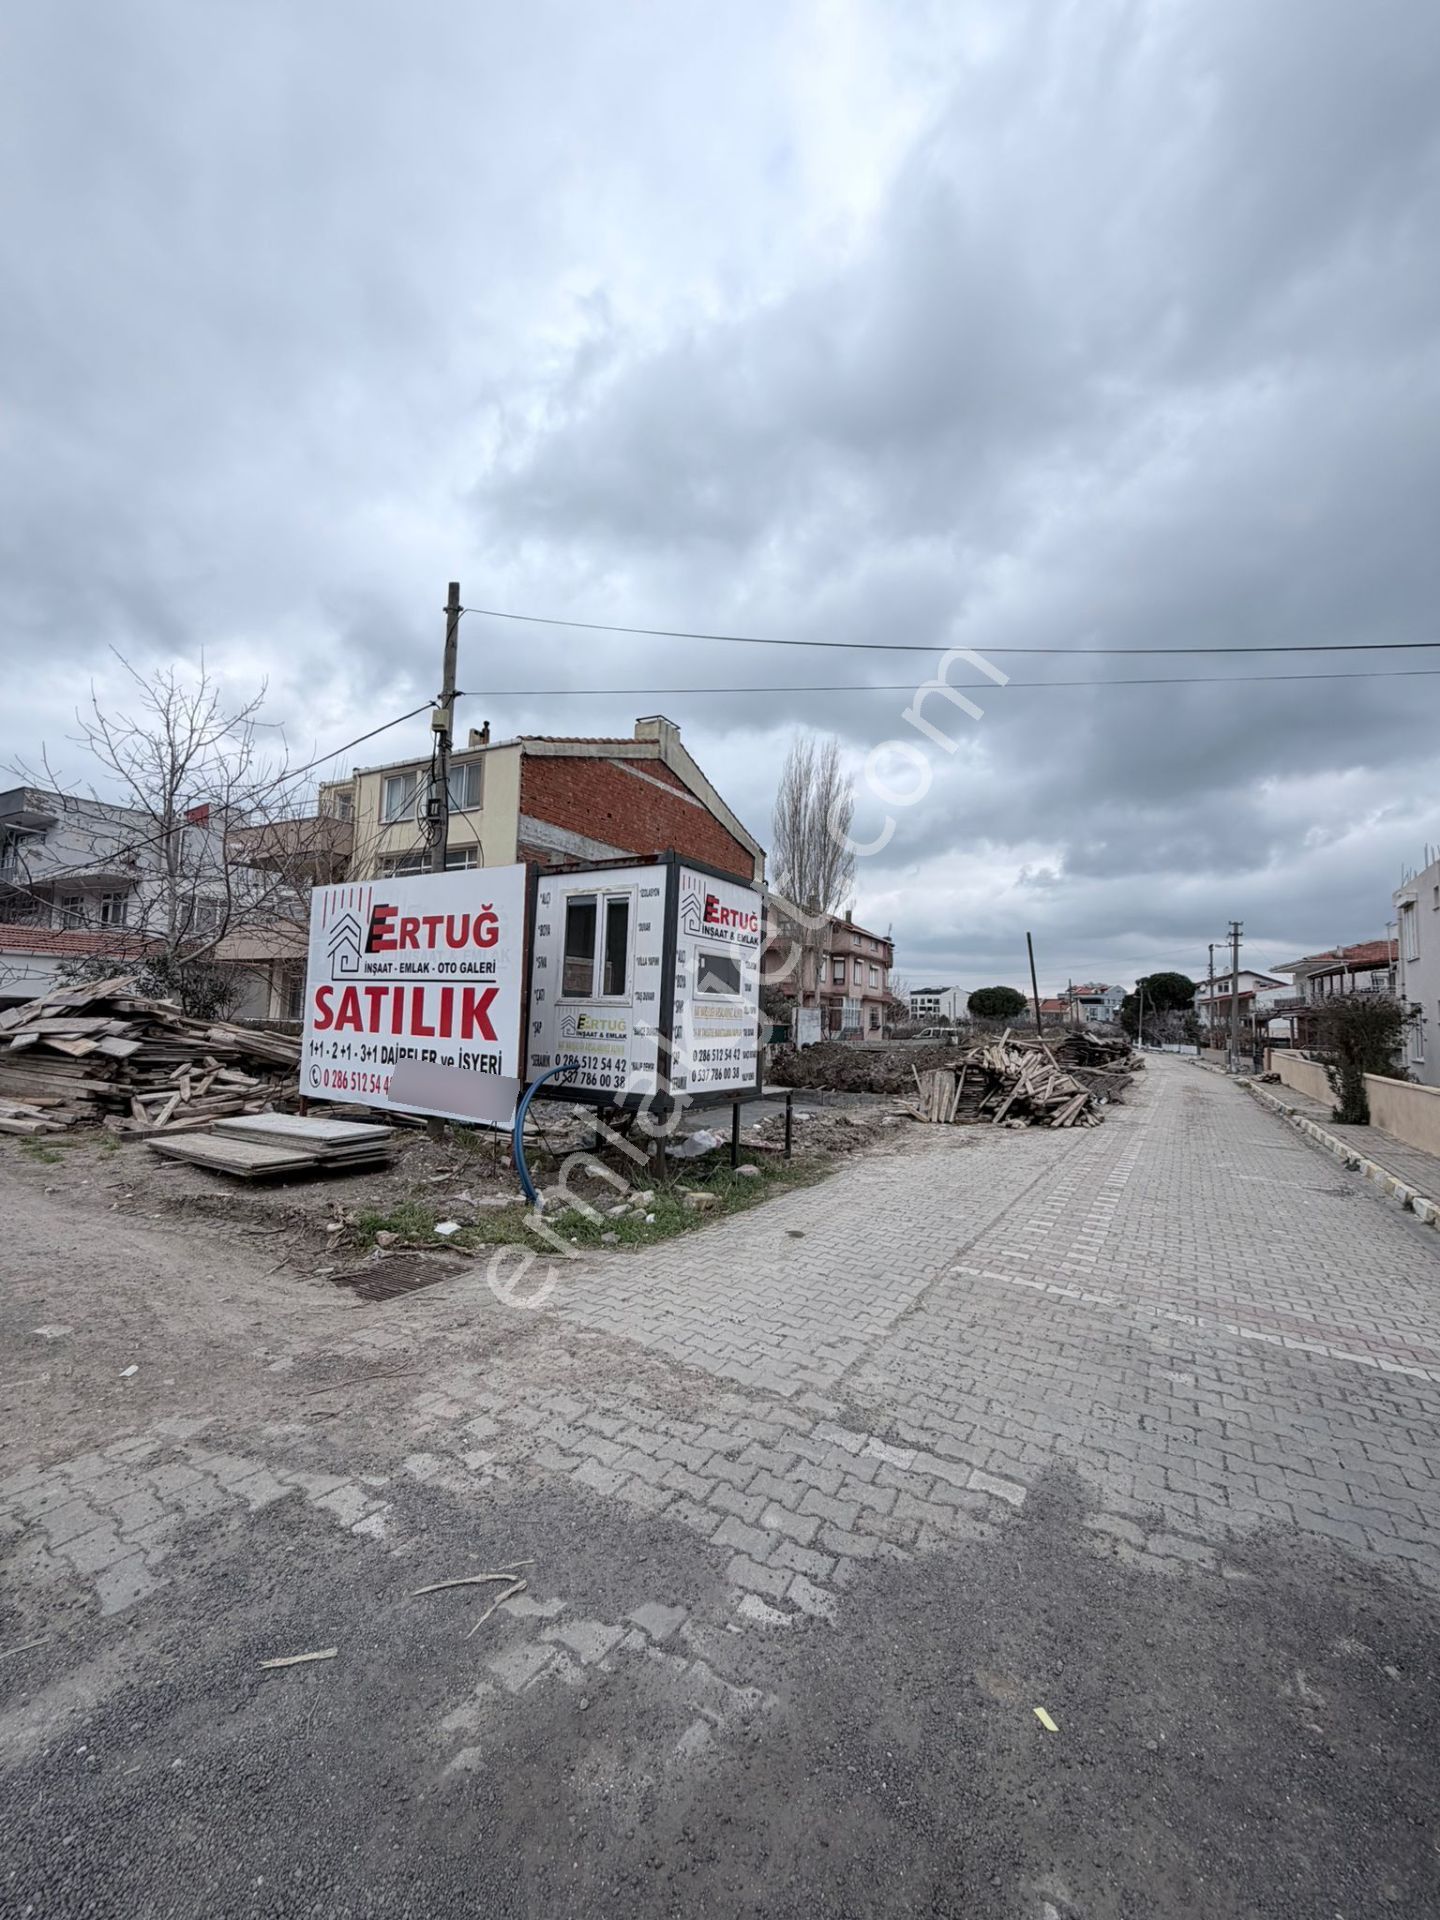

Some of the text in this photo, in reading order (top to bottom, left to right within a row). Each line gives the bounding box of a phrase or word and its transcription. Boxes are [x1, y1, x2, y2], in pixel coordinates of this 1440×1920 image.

[703, 893, 759, 932] ERTUĞ
[365, 903, 499, 954] ERTUĞ
[702, 924, 759, 946] İNŞAAT & EMLAK
[364, 961, 392, 976] İNŞAAT
[400, 961, 430, 974] EMLAK
[438, 961, 457, 974] OTO
[459, 959, 496, 974] GALERİ
[314, 985, 500, 1041] SATILIK
[577, 1013, 626, 1031] ERTUĞ
[310, 1040, 324, 1058] 1+1
[361, 1044, 377, 1063] 3+1
[441, 1055, 455, 1066] ve
[555, 1053, 627, 1072] 0 286 512 54 42
[693, 1050, 698, 1062] 0
[699, 1049, 710, 1062] 286
[712, 1049, 723, 1061] 512
[725, 1048, 732, 1061] 54
[733, 1048, 740, 1060] 42
[324, 1069, 330, 1087] 0
[332, 1070, 348, 1089] 286
[351, 1072, 367, 1092] 512
[370, 1074, 381, 1094] 54
[580, 1071, 597, 1086] 786
[600, 1074, 611, 1088] 00
[613, 1075, 626, 1089] 38
[692, 1070, 697, 1082] 0
[698, 1069, 710, 1082] 537
[711, 1067, 722, 1080] 786
[723, 1067, 731, 1079] 00
[732, 1067, 740, 1079] 38
